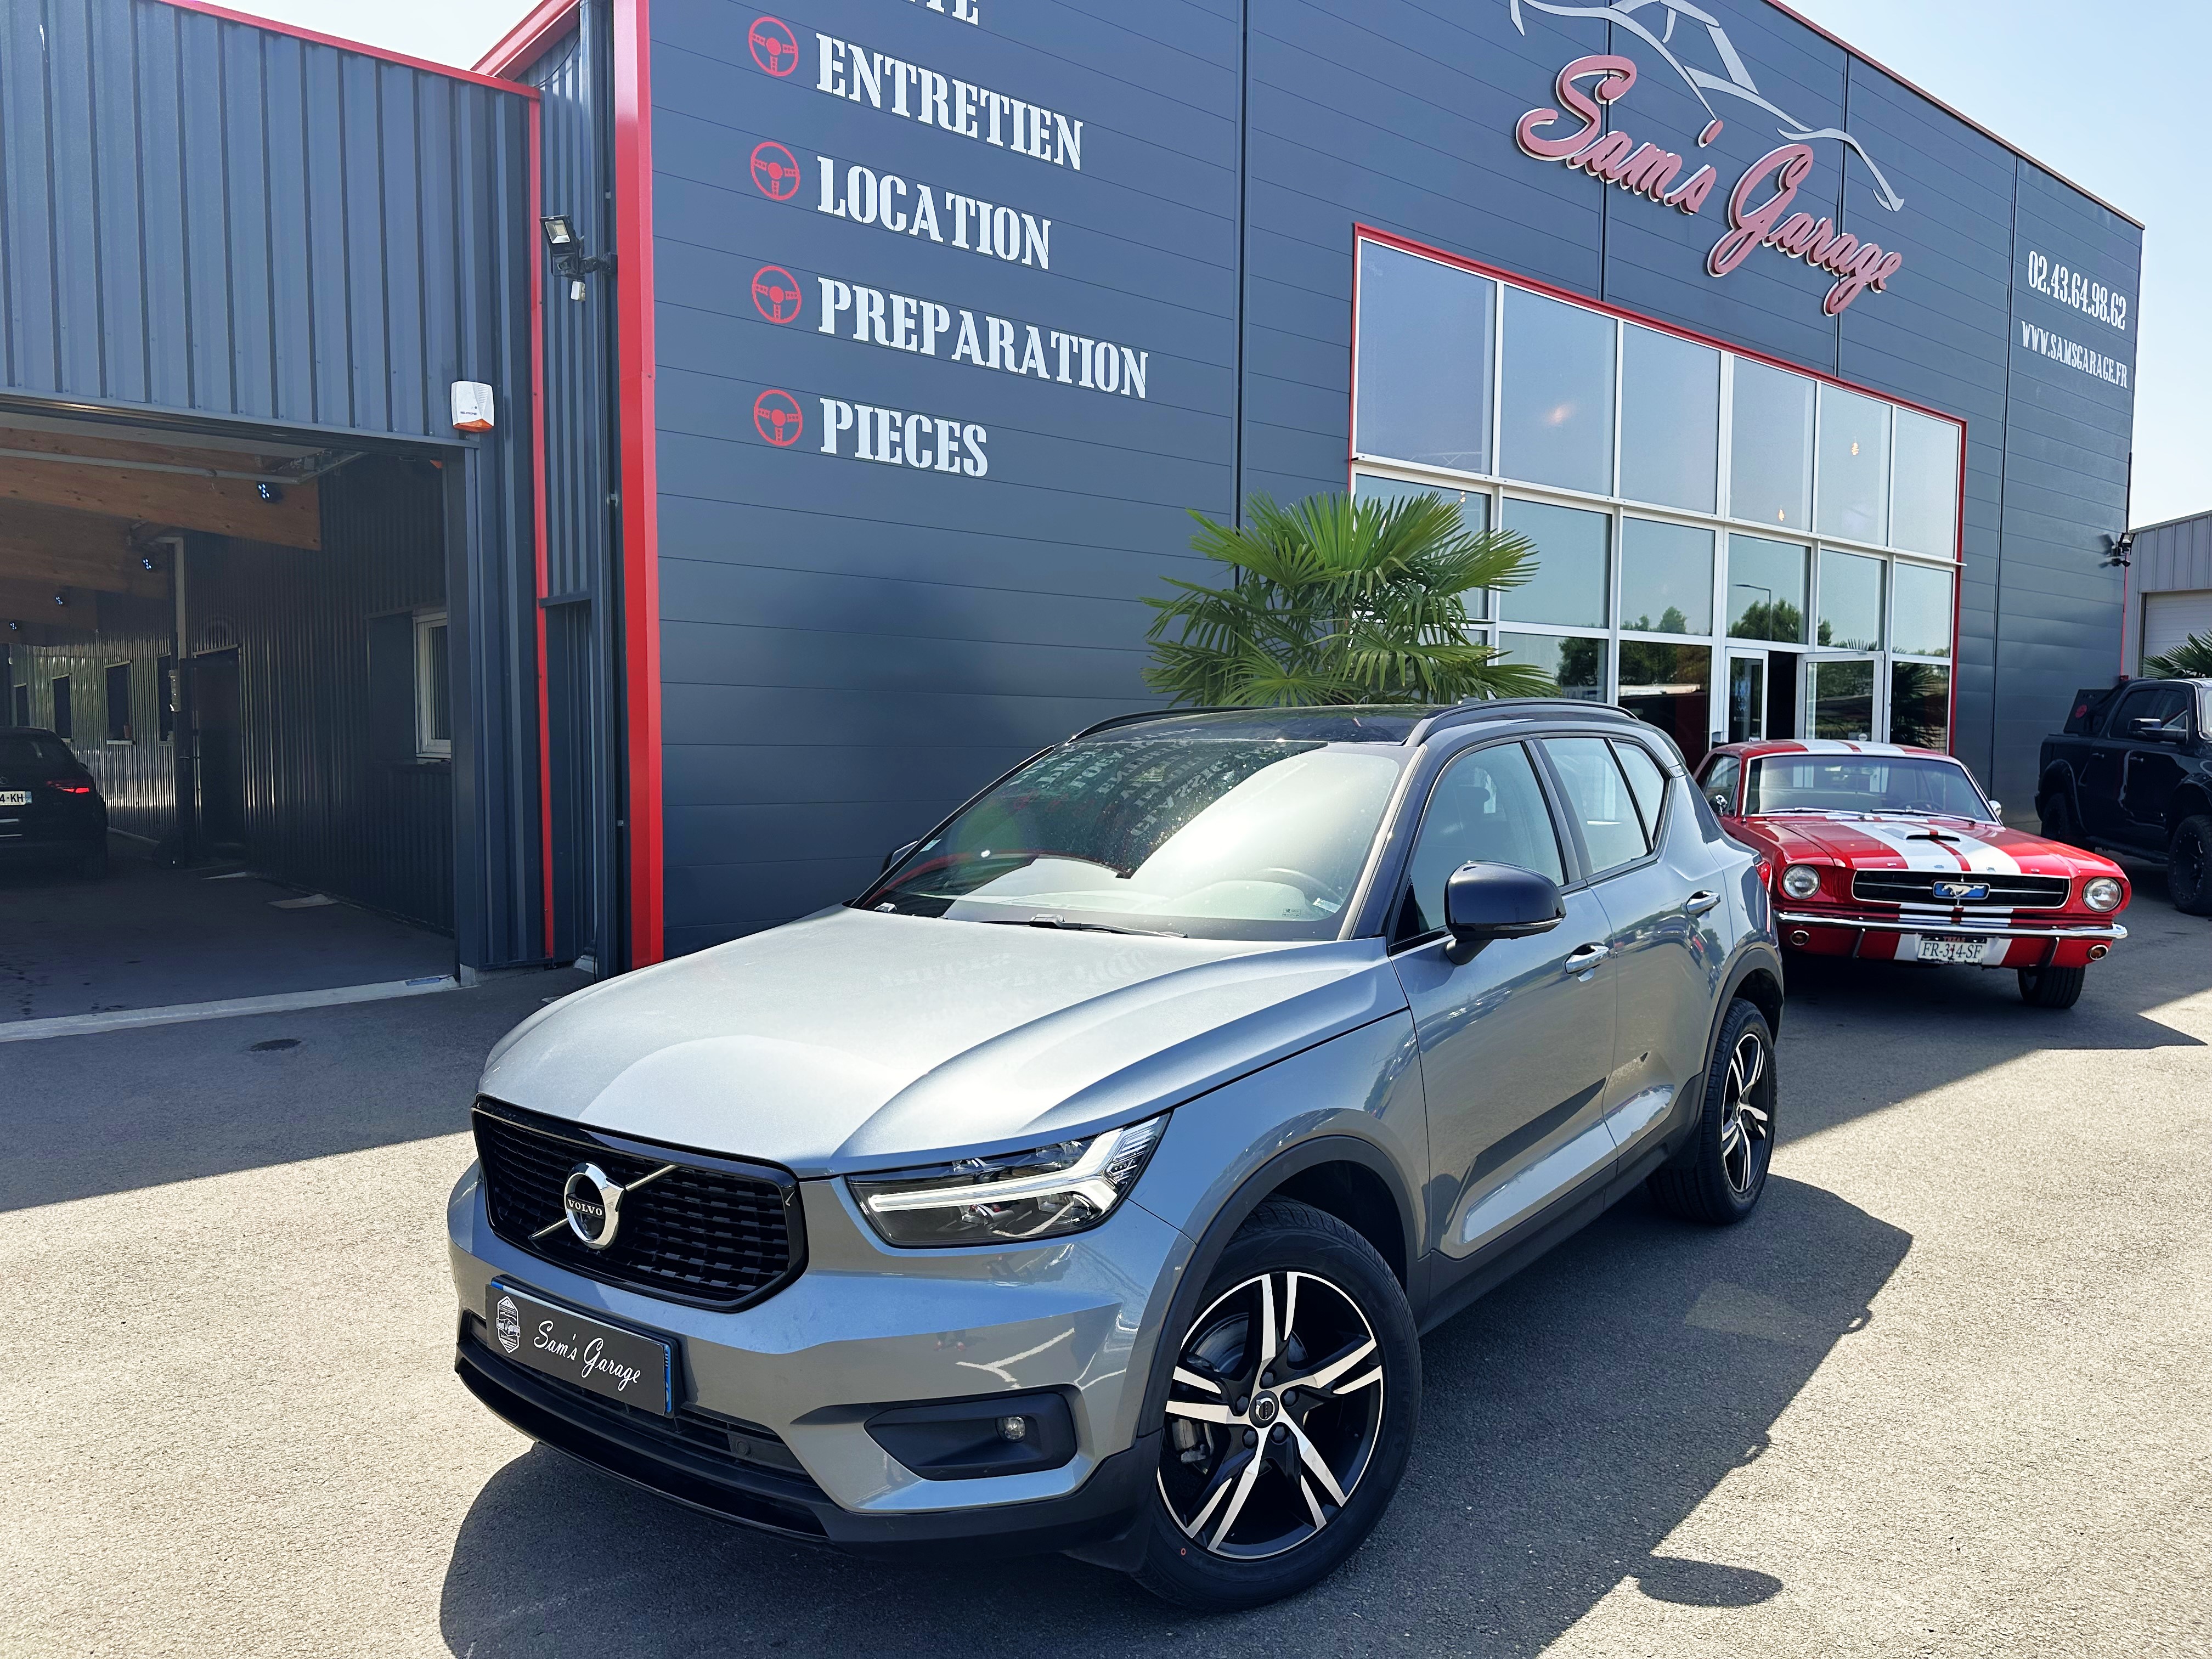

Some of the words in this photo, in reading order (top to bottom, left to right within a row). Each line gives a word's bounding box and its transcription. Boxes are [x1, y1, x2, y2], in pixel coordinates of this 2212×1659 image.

[816, 32, 1083, 170] ENTRETIEN
[817, 156, 1051, 269] LOCATION
[1516, 55, 1723, 215] Sam's
[1707, 144, 1902, 317] Garage
[2028, 251, 2126, 331] 02.43.64.98.62
[818, 276, 1149, 399] PREPARATION
[820, 398, 988, 477] PIECES
[1922, 942, 1983, 958] FR-314-SF
[567, 1199, 603, 1216] VOLVO
[534, 1320, 577, 1361] Sam's
[582, 1338, 641, 1391] Garage
